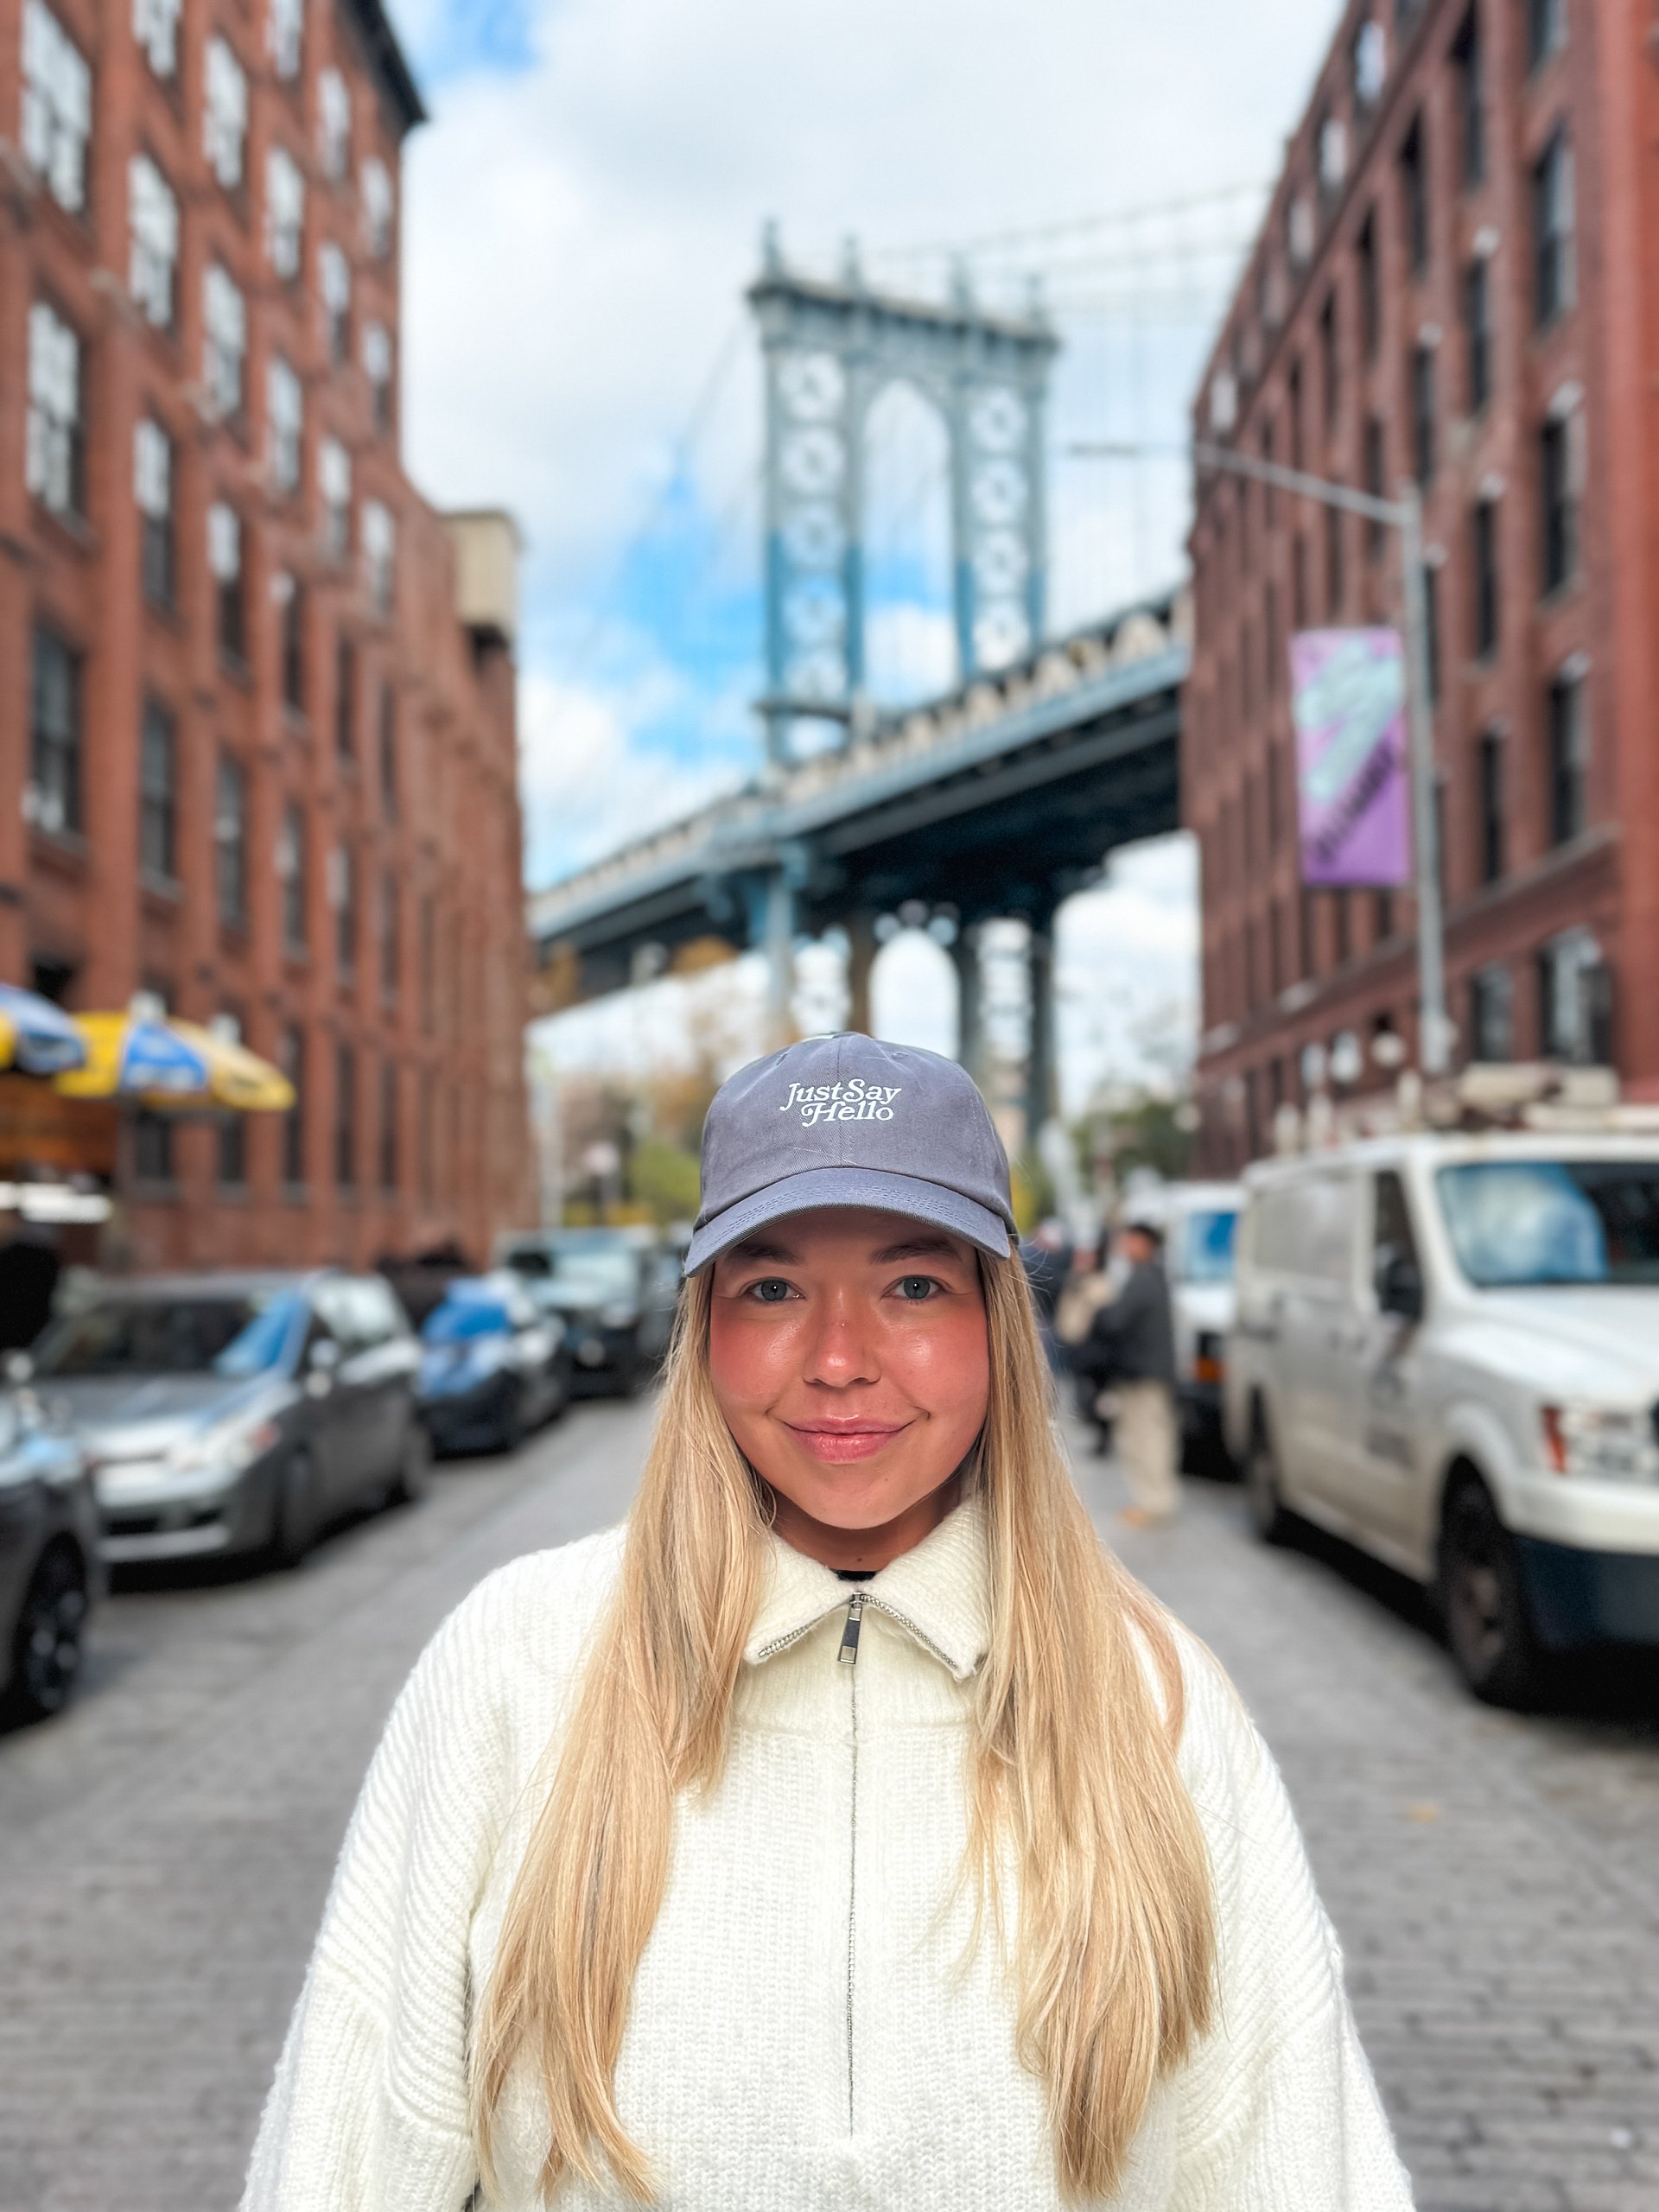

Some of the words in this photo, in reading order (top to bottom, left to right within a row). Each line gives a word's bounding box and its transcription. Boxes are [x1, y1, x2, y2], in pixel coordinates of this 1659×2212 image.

[779, 1082, 843, 1111] Just
[842, 1078, 902, 1105] Say
[801, 1101, 894, 1127] Hello
